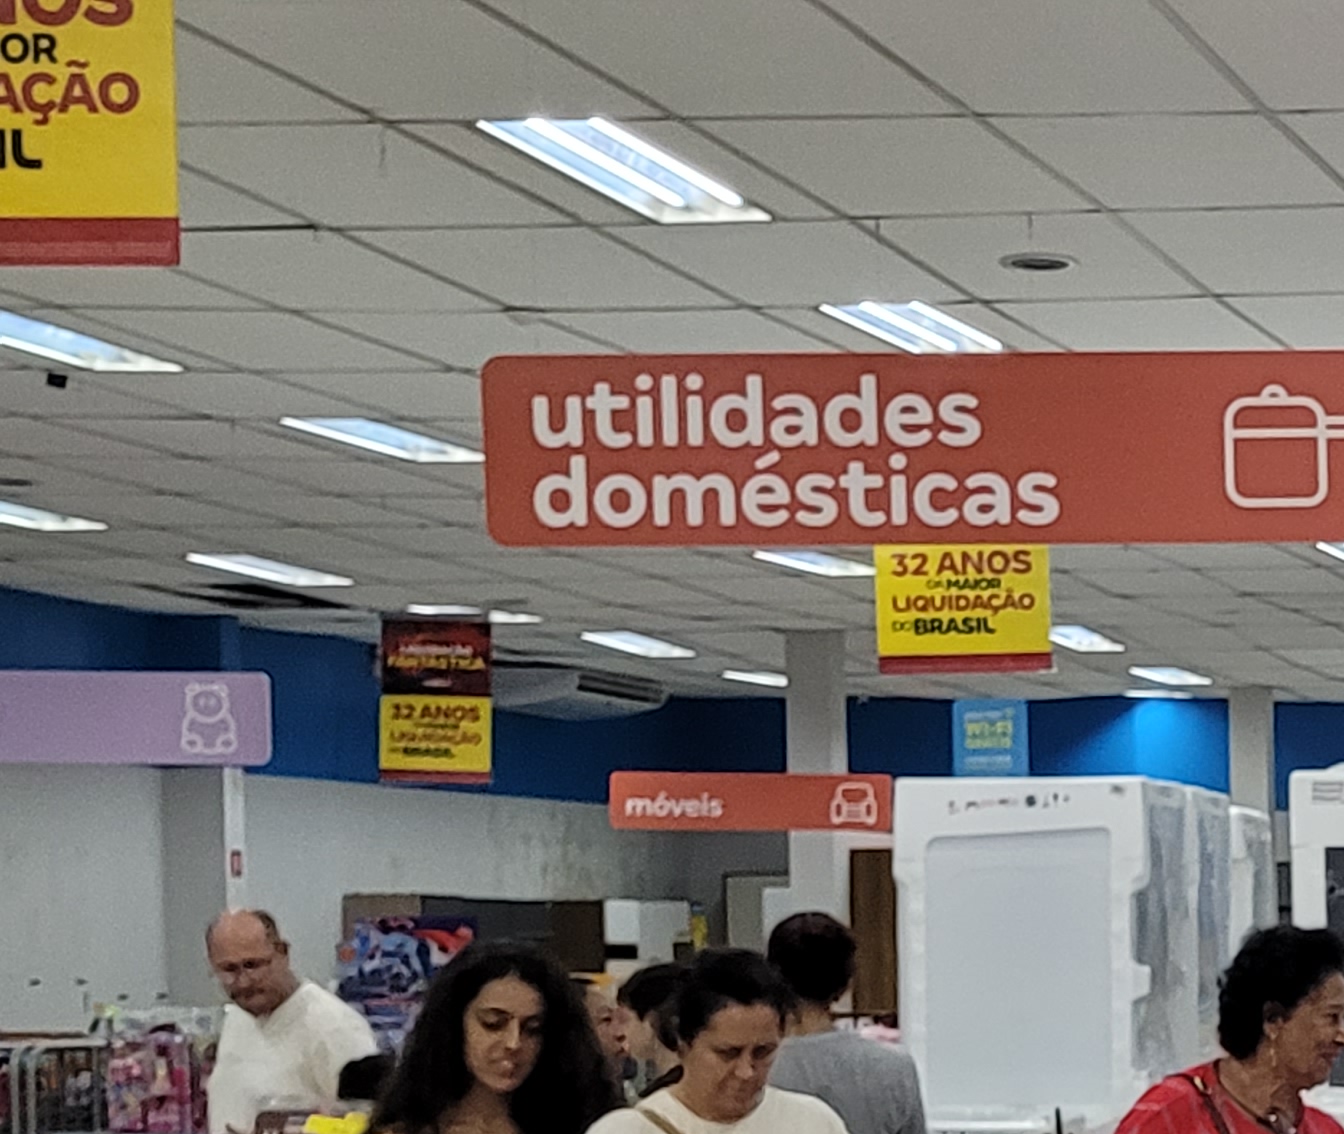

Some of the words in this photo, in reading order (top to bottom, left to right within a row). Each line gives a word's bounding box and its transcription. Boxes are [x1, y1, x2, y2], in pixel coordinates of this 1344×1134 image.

[530, 373, 982, 448] utilidades
[531, 450, 1061, 529] domésticas
[890, 552, 929, 577] 32
[935, 549, 1033, 576] ANOS
[945, 578, 1002, 591] MAIOR
[892, 587, 1036, 616] LIQUIDAÇÃO
[913, 617, 997, 636] BRASIL
[623, 787, 725, 820] móveis
